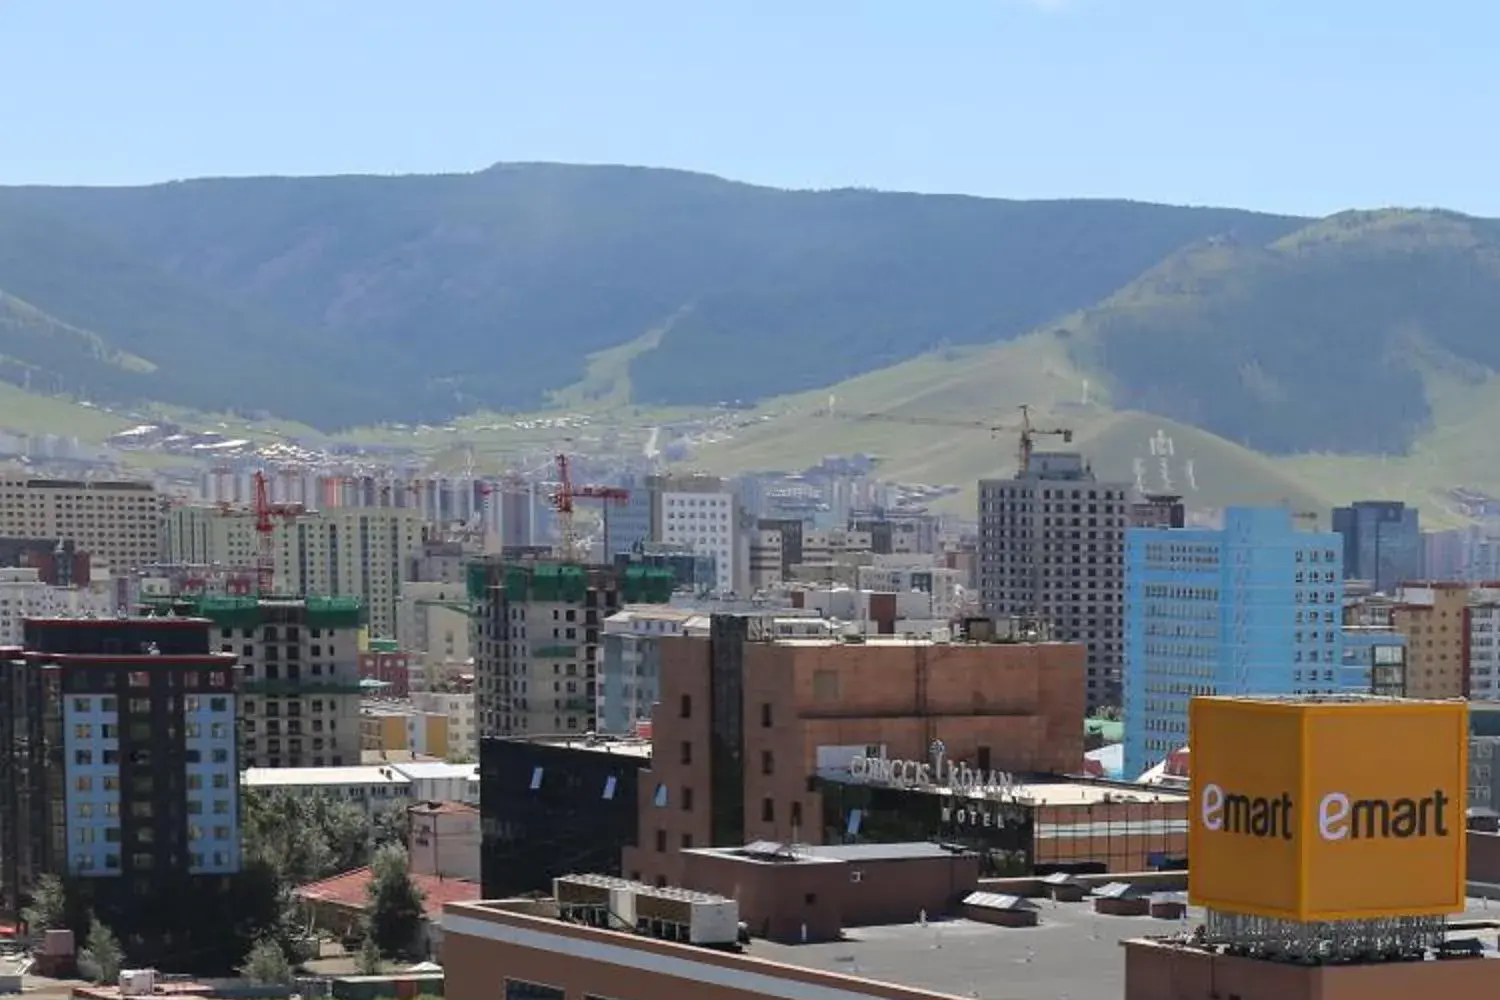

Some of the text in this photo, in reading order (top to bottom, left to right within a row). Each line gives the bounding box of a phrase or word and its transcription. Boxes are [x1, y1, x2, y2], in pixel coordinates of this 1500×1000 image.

[941, 807, 1005, 829] HOTEL
[1202, 784, 1293, 840] emart
[1319, 791, 1449, 840] emart
